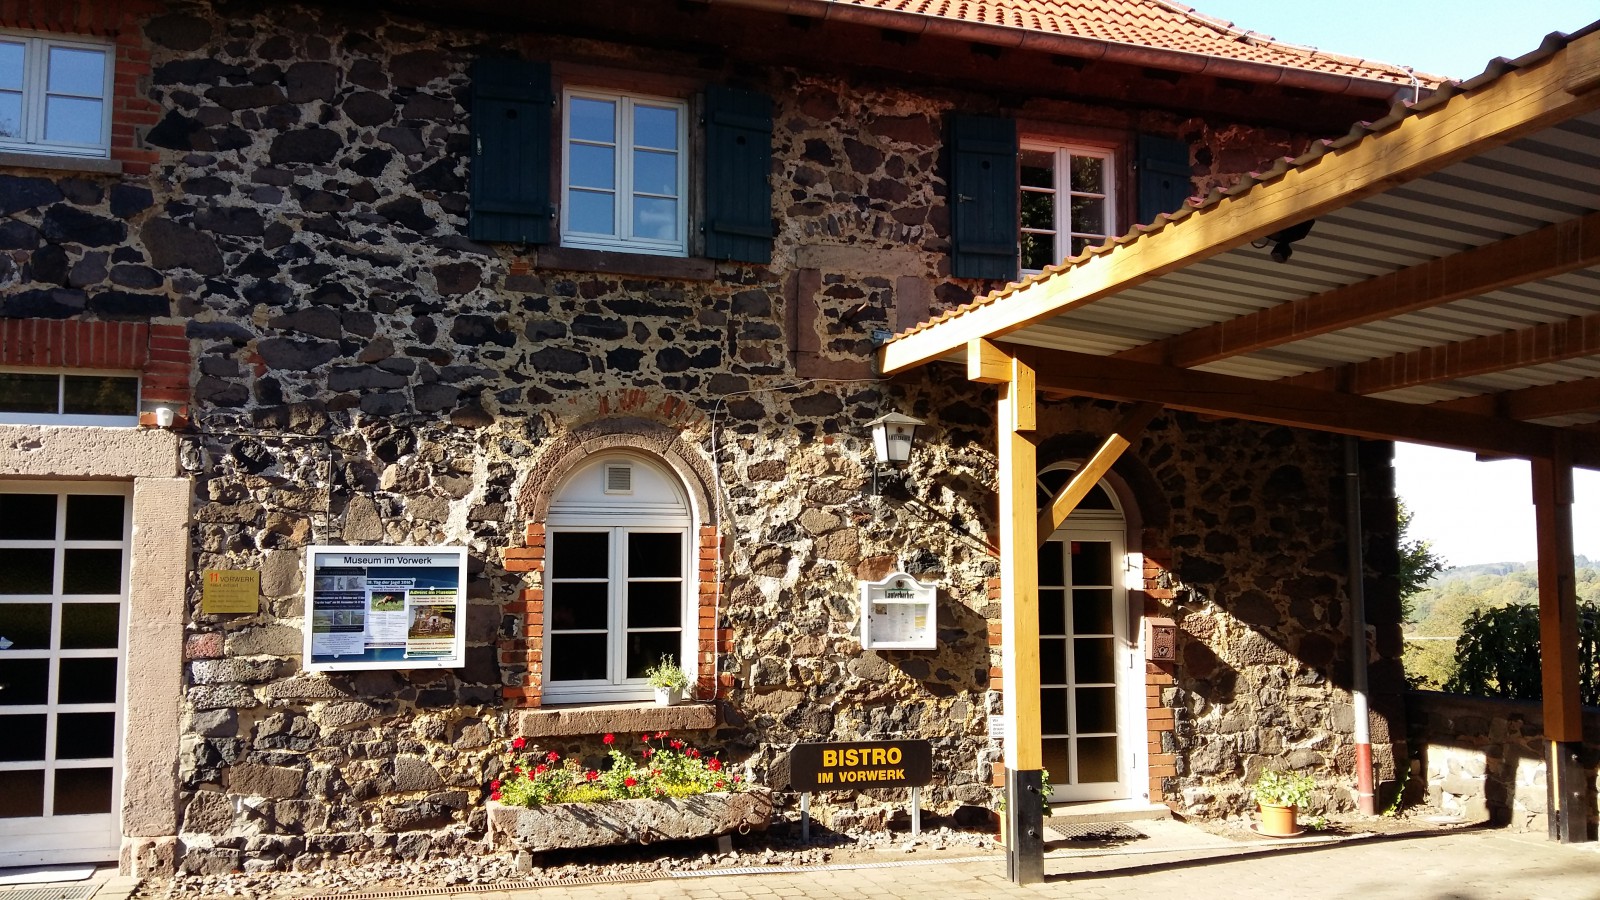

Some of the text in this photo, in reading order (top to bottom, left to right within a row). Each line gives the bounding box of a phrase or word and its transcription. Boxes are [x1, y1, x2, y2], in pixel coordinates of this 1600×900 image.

[343, 556, 432, 565] Museum im Vorwerk
[209, 572, 219, 583] 11
[823, 747, 903, 767] BISTRO
[817, 768, 906, 784] IM VORWERK
